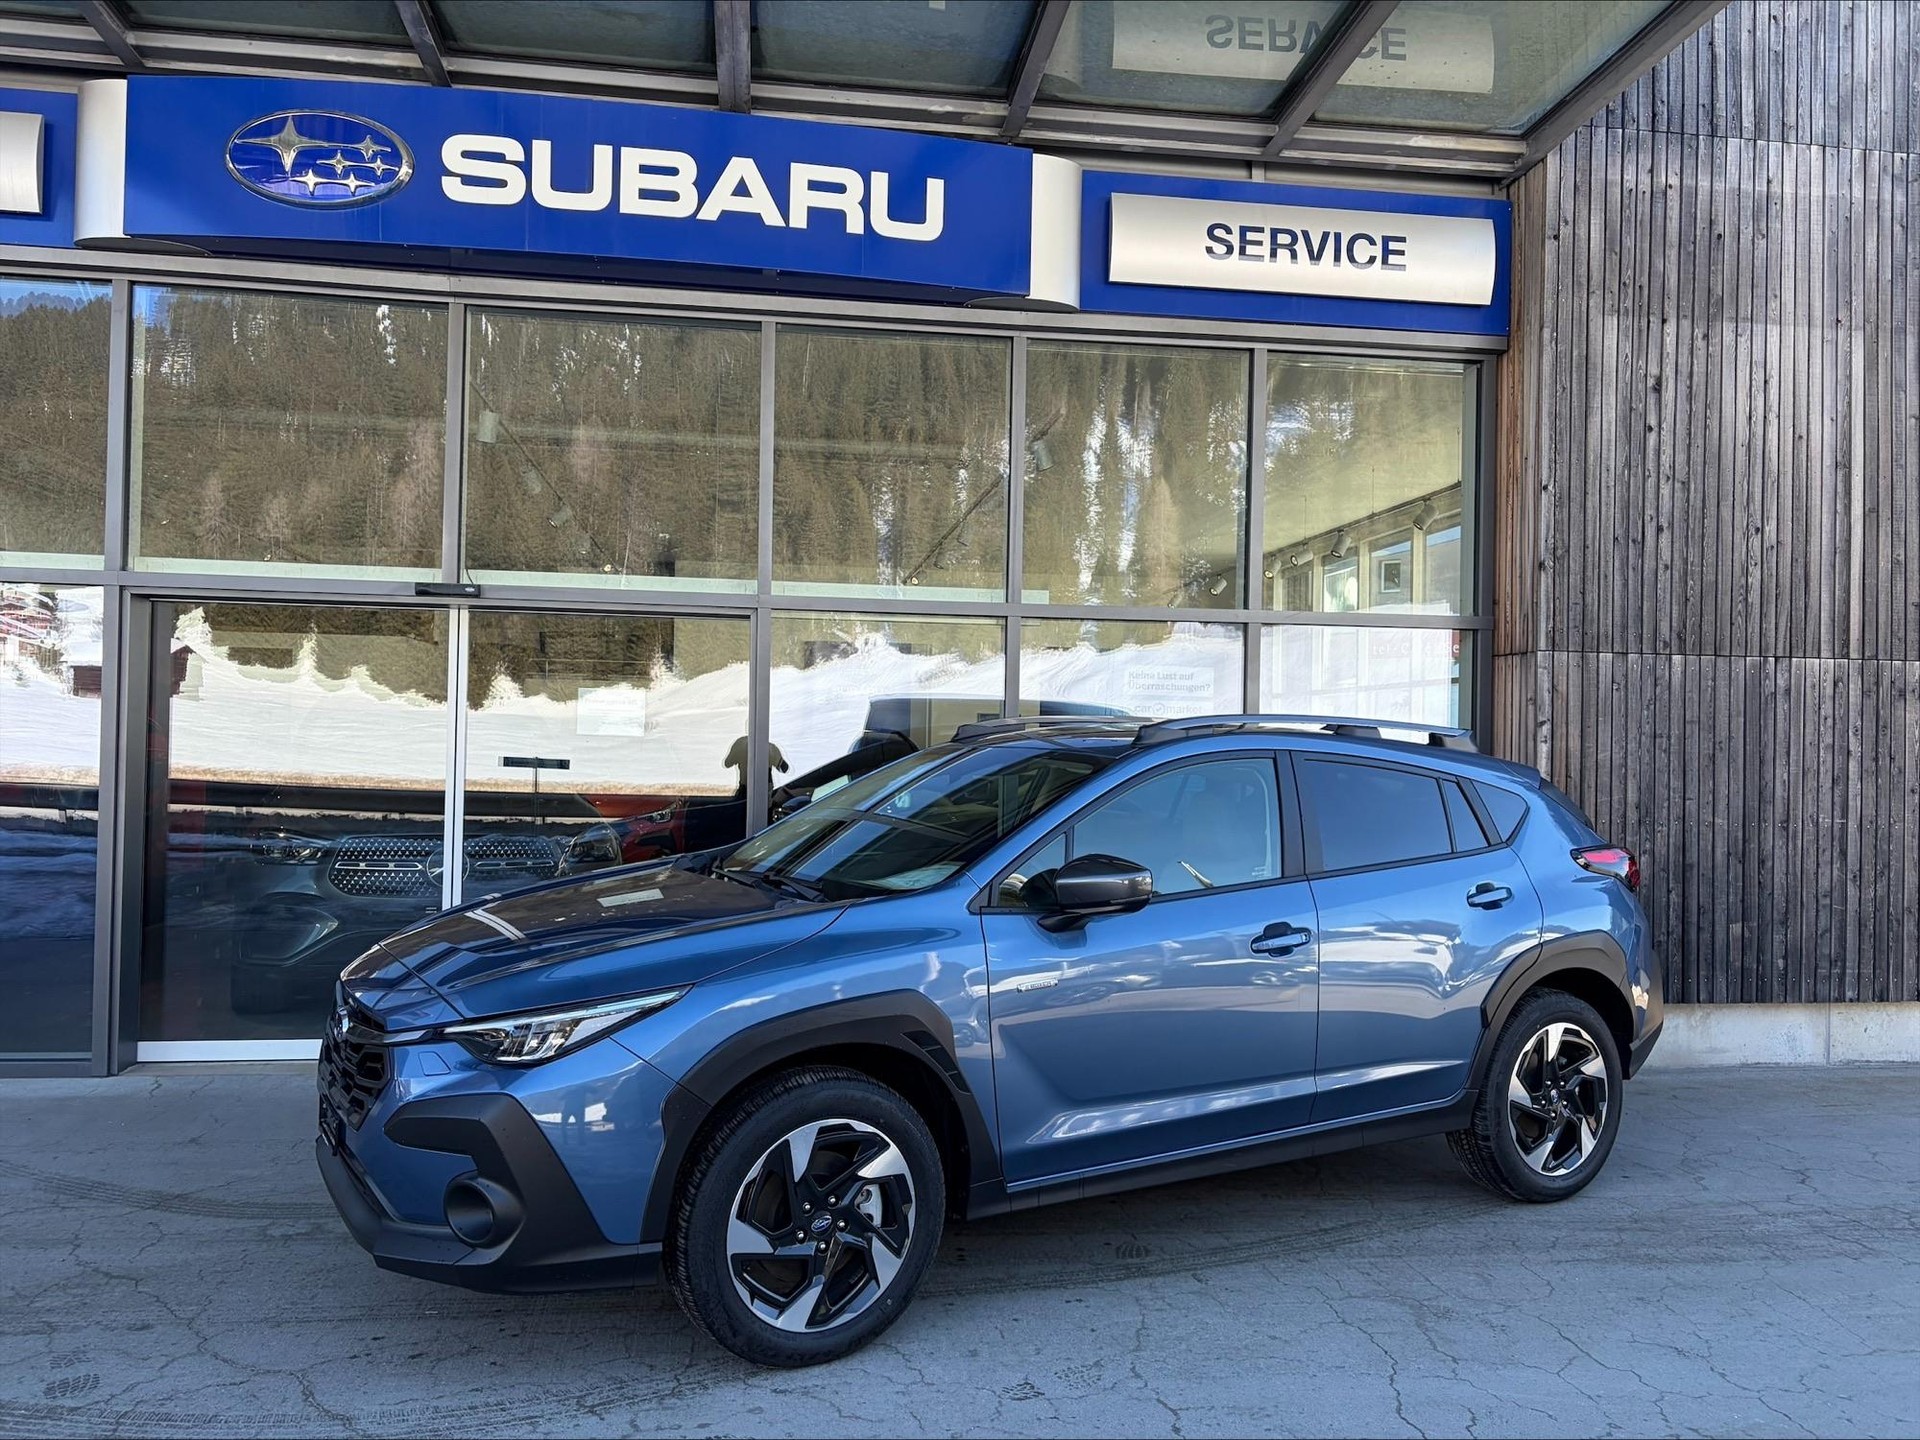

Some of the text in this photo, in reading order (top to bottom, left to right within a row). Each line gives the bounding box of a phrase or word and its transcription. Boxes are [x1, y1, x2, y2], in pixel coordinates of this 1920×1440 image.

[441, 133, 945, 241] SUBARU
[1205, 222, 1407, 271] SERVICE
[1157, 671, 1177, 681] Lust
[1179, 671, 1195, 682] auf
